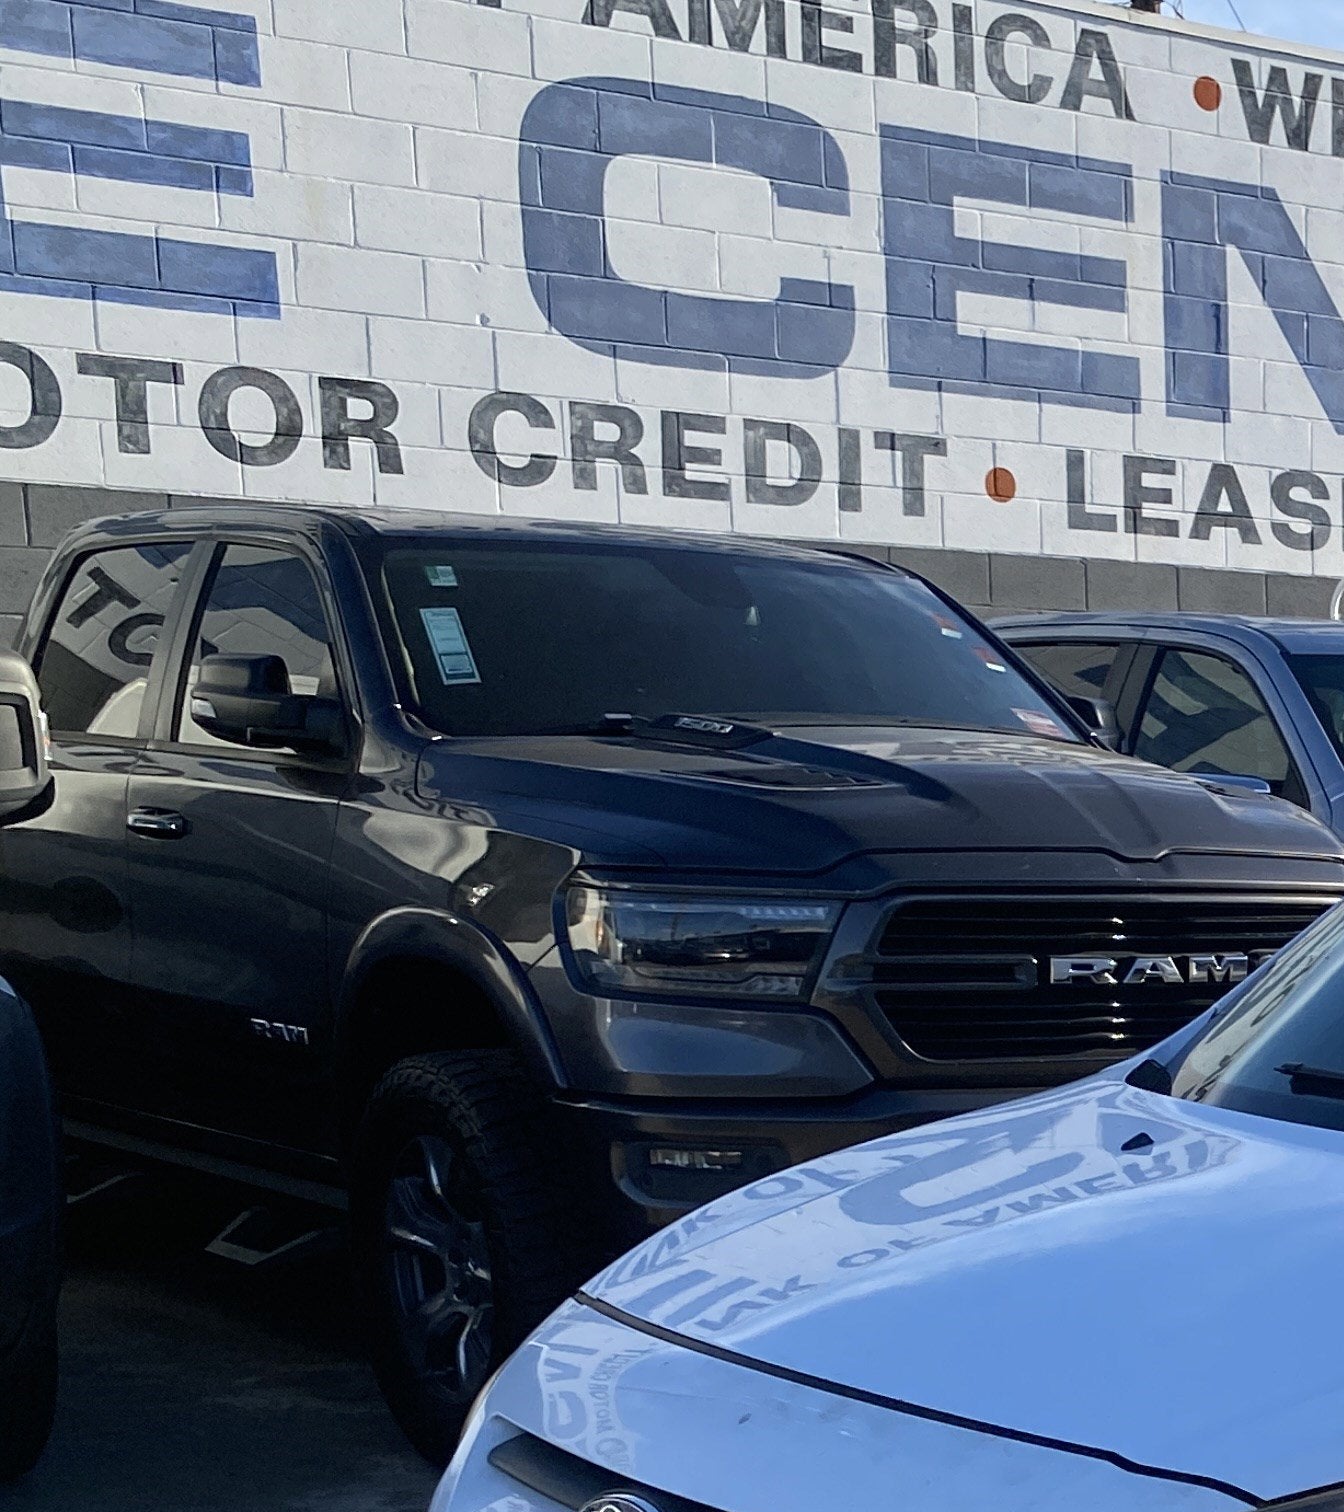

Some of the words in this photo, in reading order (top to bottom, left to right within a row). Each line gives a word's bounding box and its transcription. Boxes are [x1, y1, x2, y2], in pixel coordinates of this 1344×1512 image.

[0, 341, 404, 475] OTOR
[468, 391, 947, 518] CREDIT
[1050, 954, 1249, 984] RAM
